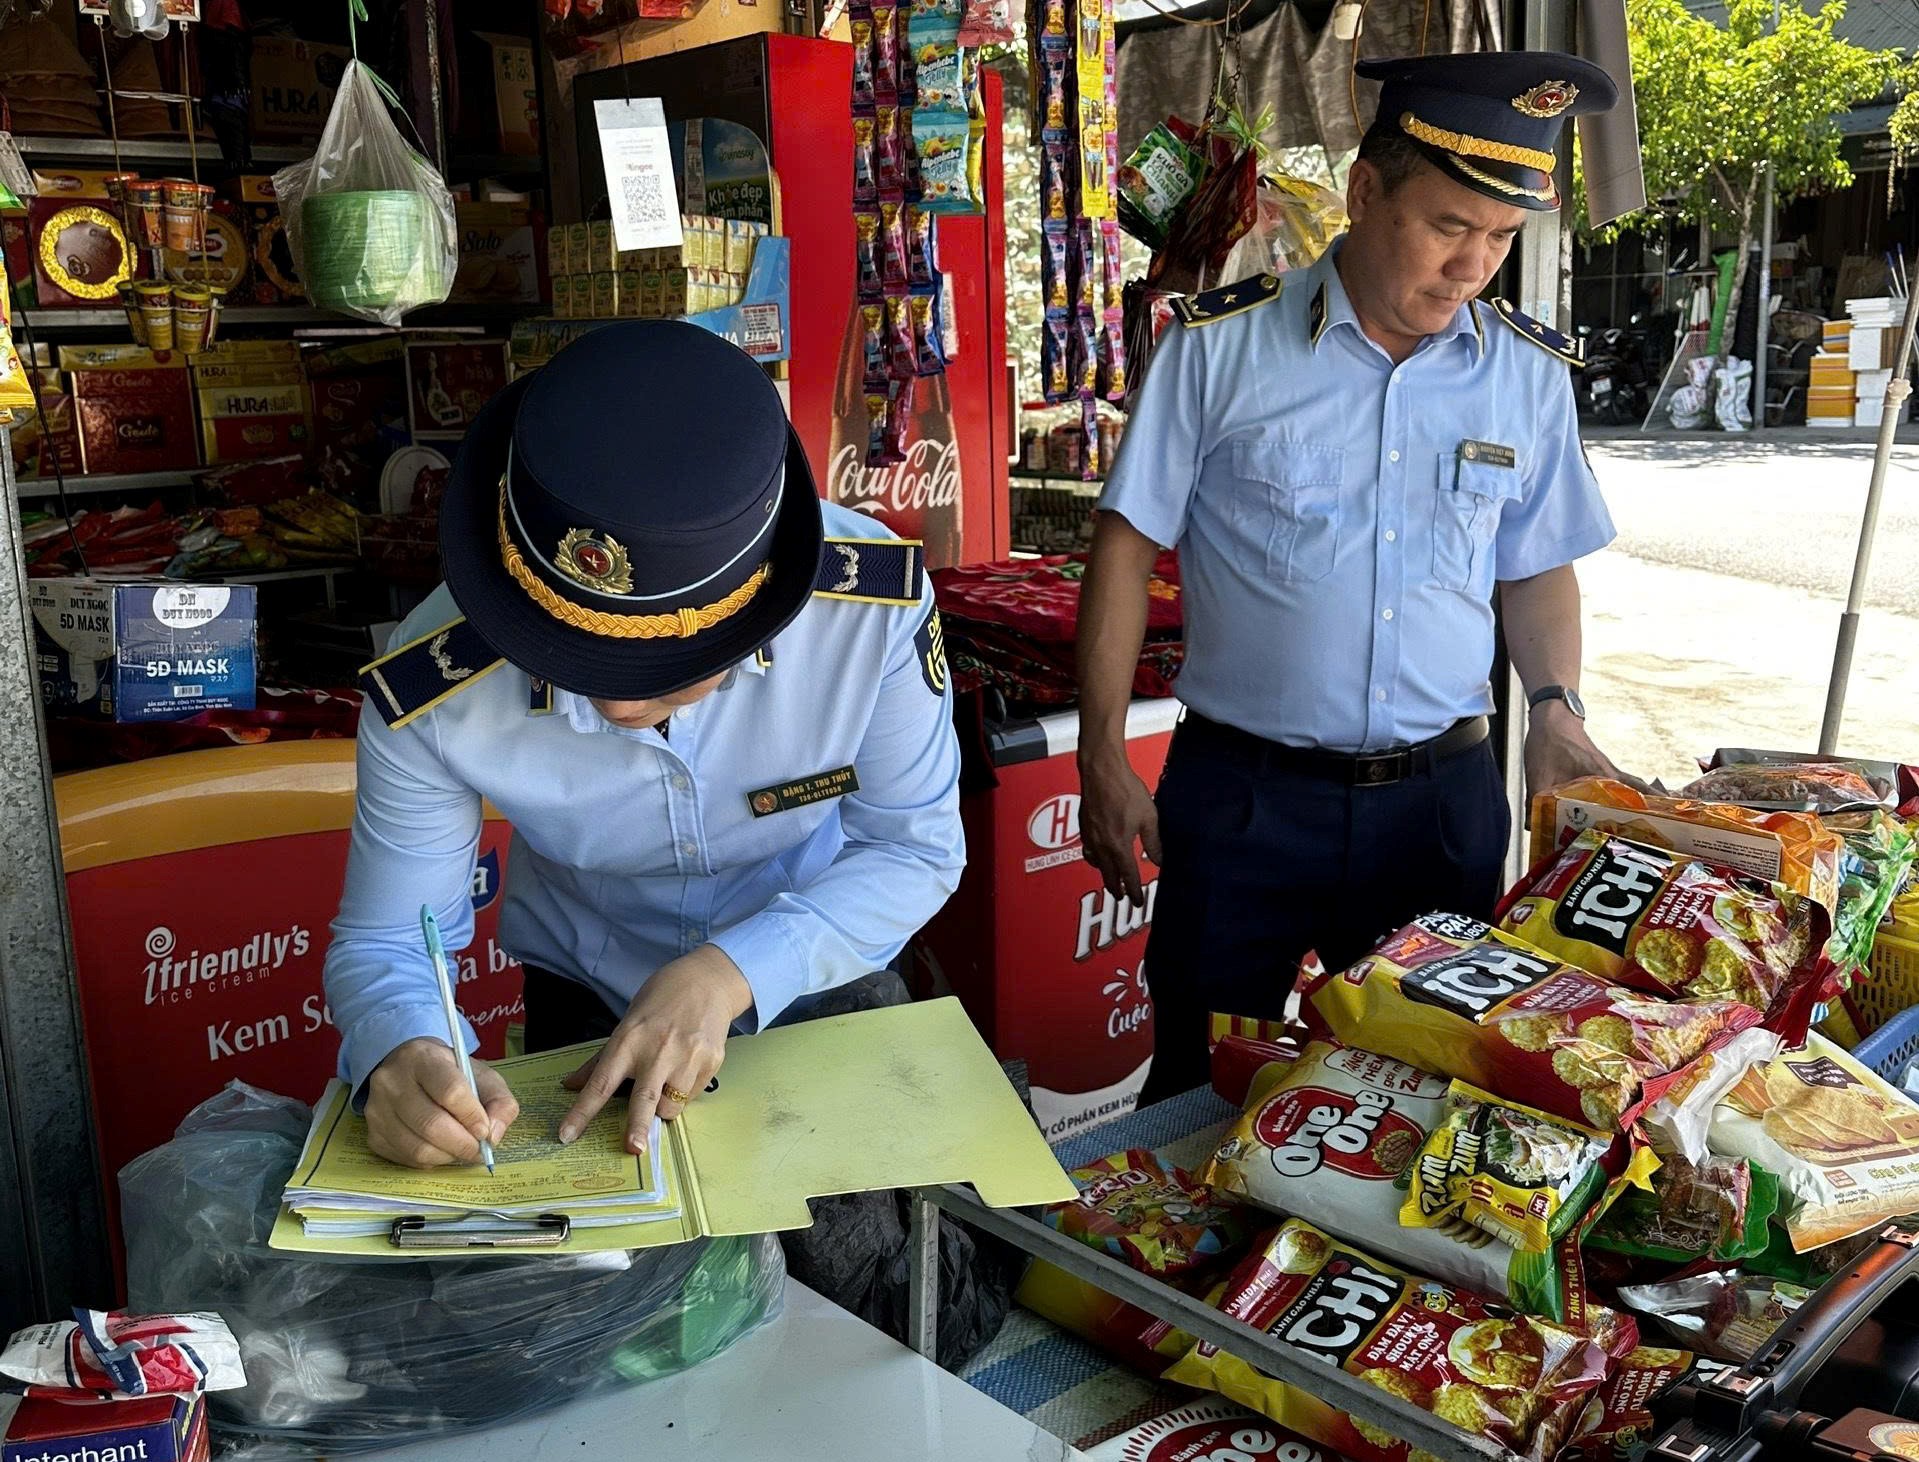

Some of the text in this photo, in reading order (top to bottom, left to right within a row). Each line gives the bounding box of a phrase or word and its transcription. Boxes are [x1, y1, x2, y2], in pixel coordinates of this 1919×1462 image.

[227, 398, 268, 413] HURA
[60, 613, 109, 633] 5D MASK
[146, 659, 229, 677] 5D MASK
[160, 966, 270, 1006] ice cream
[207, 1014, 289, 1061] Kem
[1098, 1100, 1119, 1116] KEM
[1322, 1089, 1394, 1154] One
[1271, 1105, 1342, 1177] One
[1569, 1264, 1580, 1289] THÊM
[1226, 1279, 1258, 1315] KAMEDA
[1418, 1330, 1439, 1350] ONG
[1170, 1442, 1204, 1462] Bánh
